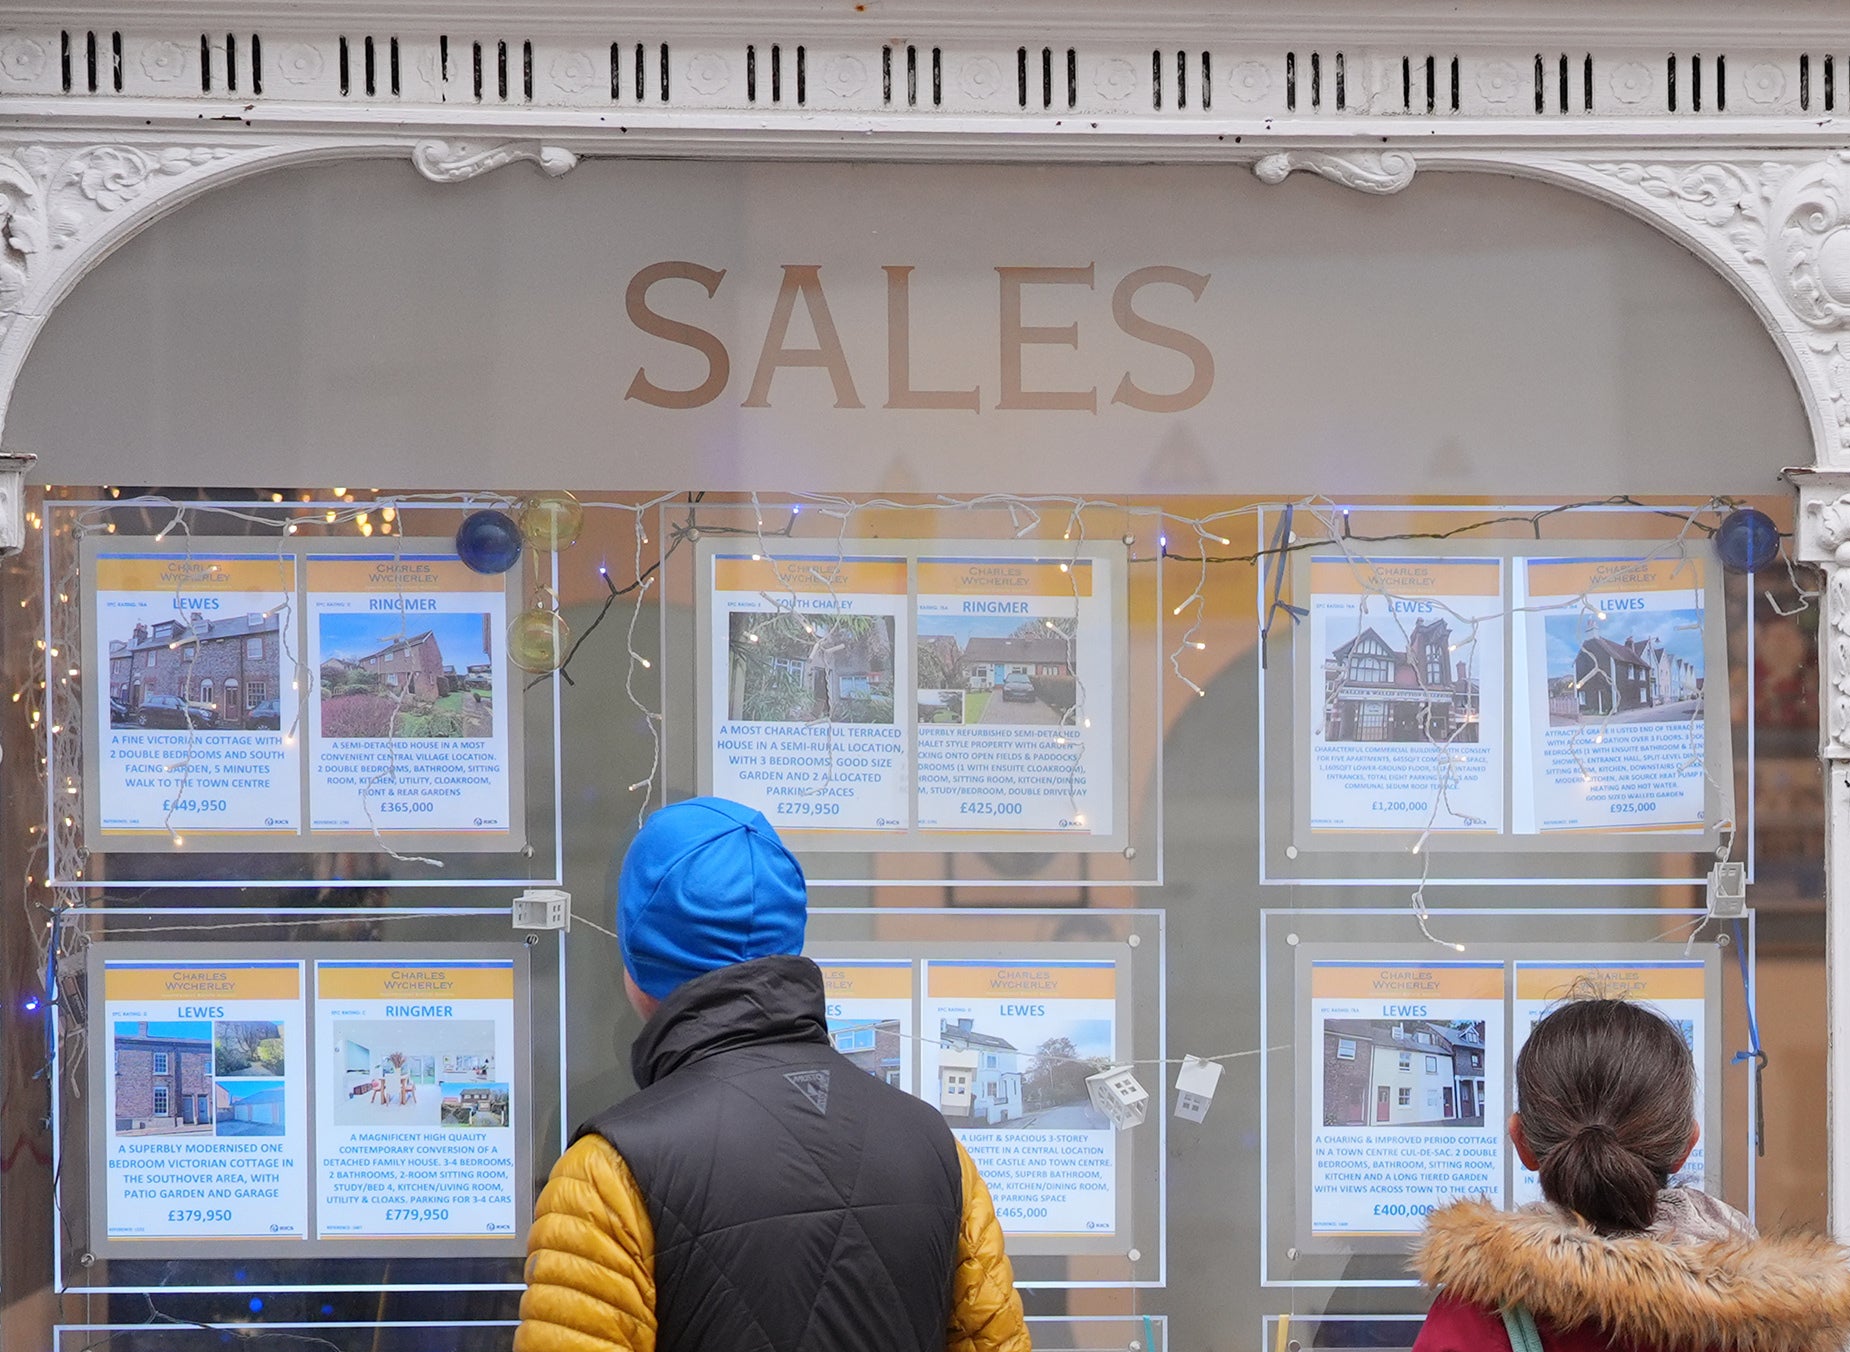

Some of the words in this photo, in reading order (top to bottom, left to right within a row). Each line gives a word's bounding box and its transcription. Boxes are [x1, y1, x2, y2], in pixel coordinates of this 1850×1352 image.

[624, 261, 1215, 413] SALES
[173, 598, 219, 609] LEWES
[963, 602, 1028, 613] RINGMER
[1601, 599, 1644, 610] LEWES
[381, 803, 433, 812] £365,000
[778, 803, 839, 814] £279,950
[960, 803, 1022, 814] £425,000
[1372, 802, 1427, 811] £1,200,000
[1611, 803, 1656, 812] £925,000
[173, 972, 227, 981] CHARLES
[391, 971, 445, 980] CHARLES
[995, 970, 1050, 979] CHARLES
[988, 980, 1057, 989] WYCHERLEY
[178, 1007, 224, 1018] LEWES
[386, 1006, 452, 1016] RINGMER
[1001, 1005, 1044, 1016] LEWES
[1383, 1006, 1427, 1016] LEWES
[119, 1145, 126, 1153] A
[128, 1145, 182, 1153] SUPERBLY
[186, 1144, 257, 1152] MODERNISED
[261, 1144, 282, 1152] ONE
[109, 1160, 165, 1168] BEDROOM
[167, 1160, 226, 1168] VICTORIAN
[230, 1159, 278, 1167] COTTAGE
[124, 1175, 143, 1183] THE
[147, 1175, 212, 1183] SOUTHOVER
[216, 1174, 247, 1183] AREA,
[251, 1174, 279, 1182] WITH
[125, 1190, 156, 1198] PATIO
[160, 1190, 204, 1198] GARDEN
[206, 1189, 231, 1198] AND
[235, 1189, 278, 1197] GARAGE
[169, 1210, 232, 1221] £379,950
[386, 1209, 448, 1220] £779,950
[994, 1208, 1047, 1217] £465,000
